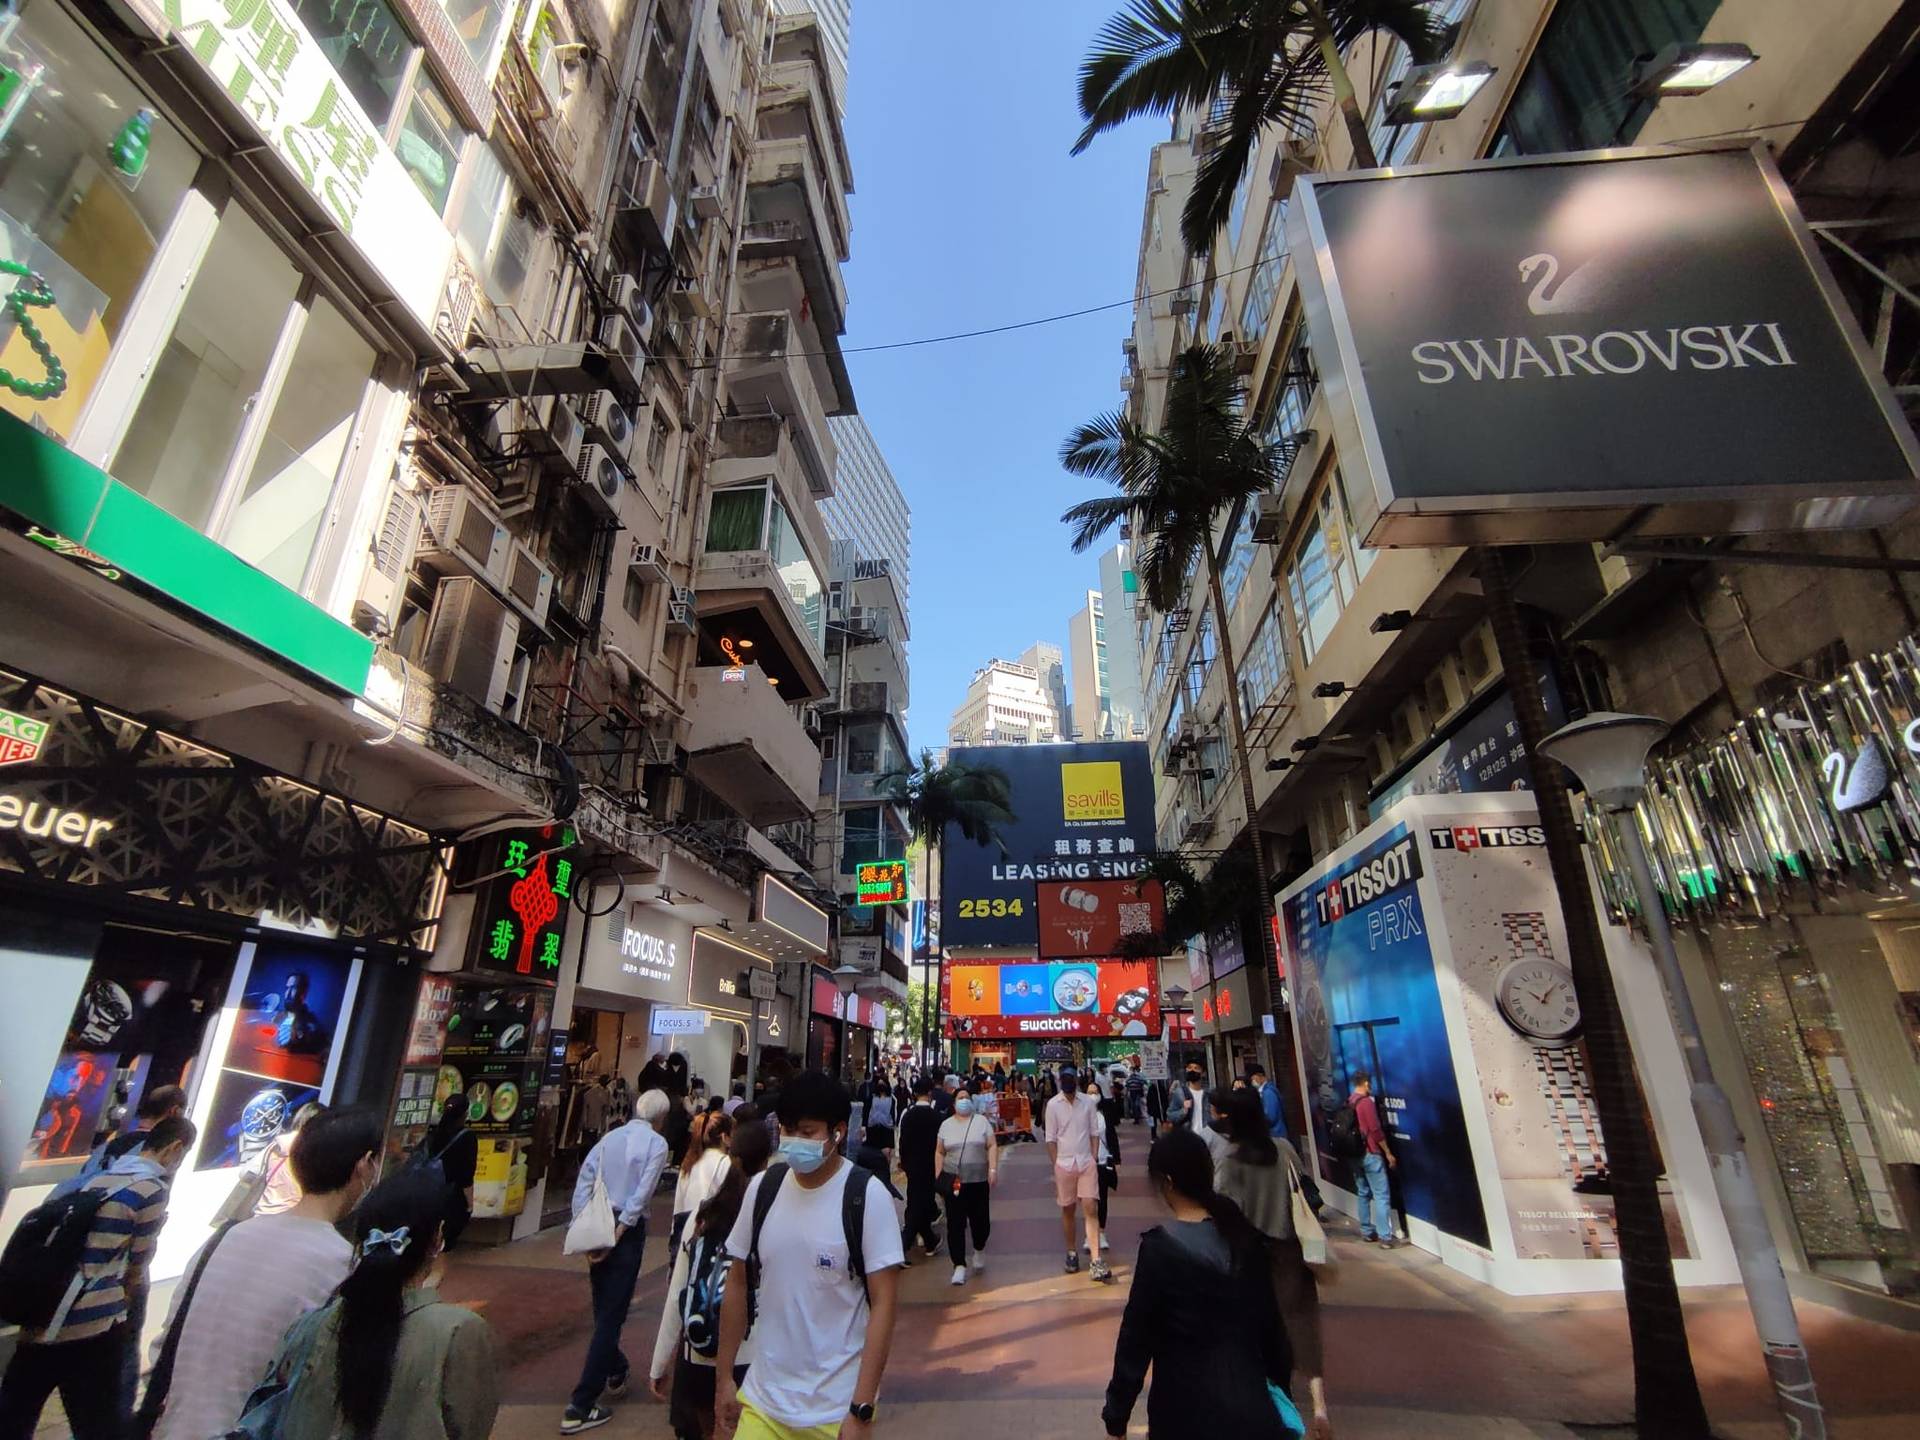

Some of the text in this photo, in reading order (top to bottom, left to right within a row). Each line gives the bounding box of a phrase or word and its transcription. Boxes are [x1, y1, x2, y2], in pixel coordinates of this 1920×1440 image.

[1411, 322, 1798, 384] SWAROVSKI
[1066, 789, 1121, 808] savills
[1054, 837, 1135, 856] 租務查詢
[1480, 826, 1547, 847] TISS
[992, 862, 1090, 881] LEASING
[1341, 839, 1412, 909] TISSOT
[958, 898, 1024, 918] 2534
[1367, 895, 1423, 951] PRX
[424, 980, 452, 1002] Nail
[417, 1001, 447, 1023] Box
[1019, 1017, 1071, 1032] swatch
[1518, 1210, 1547, 1219] TISSOT
